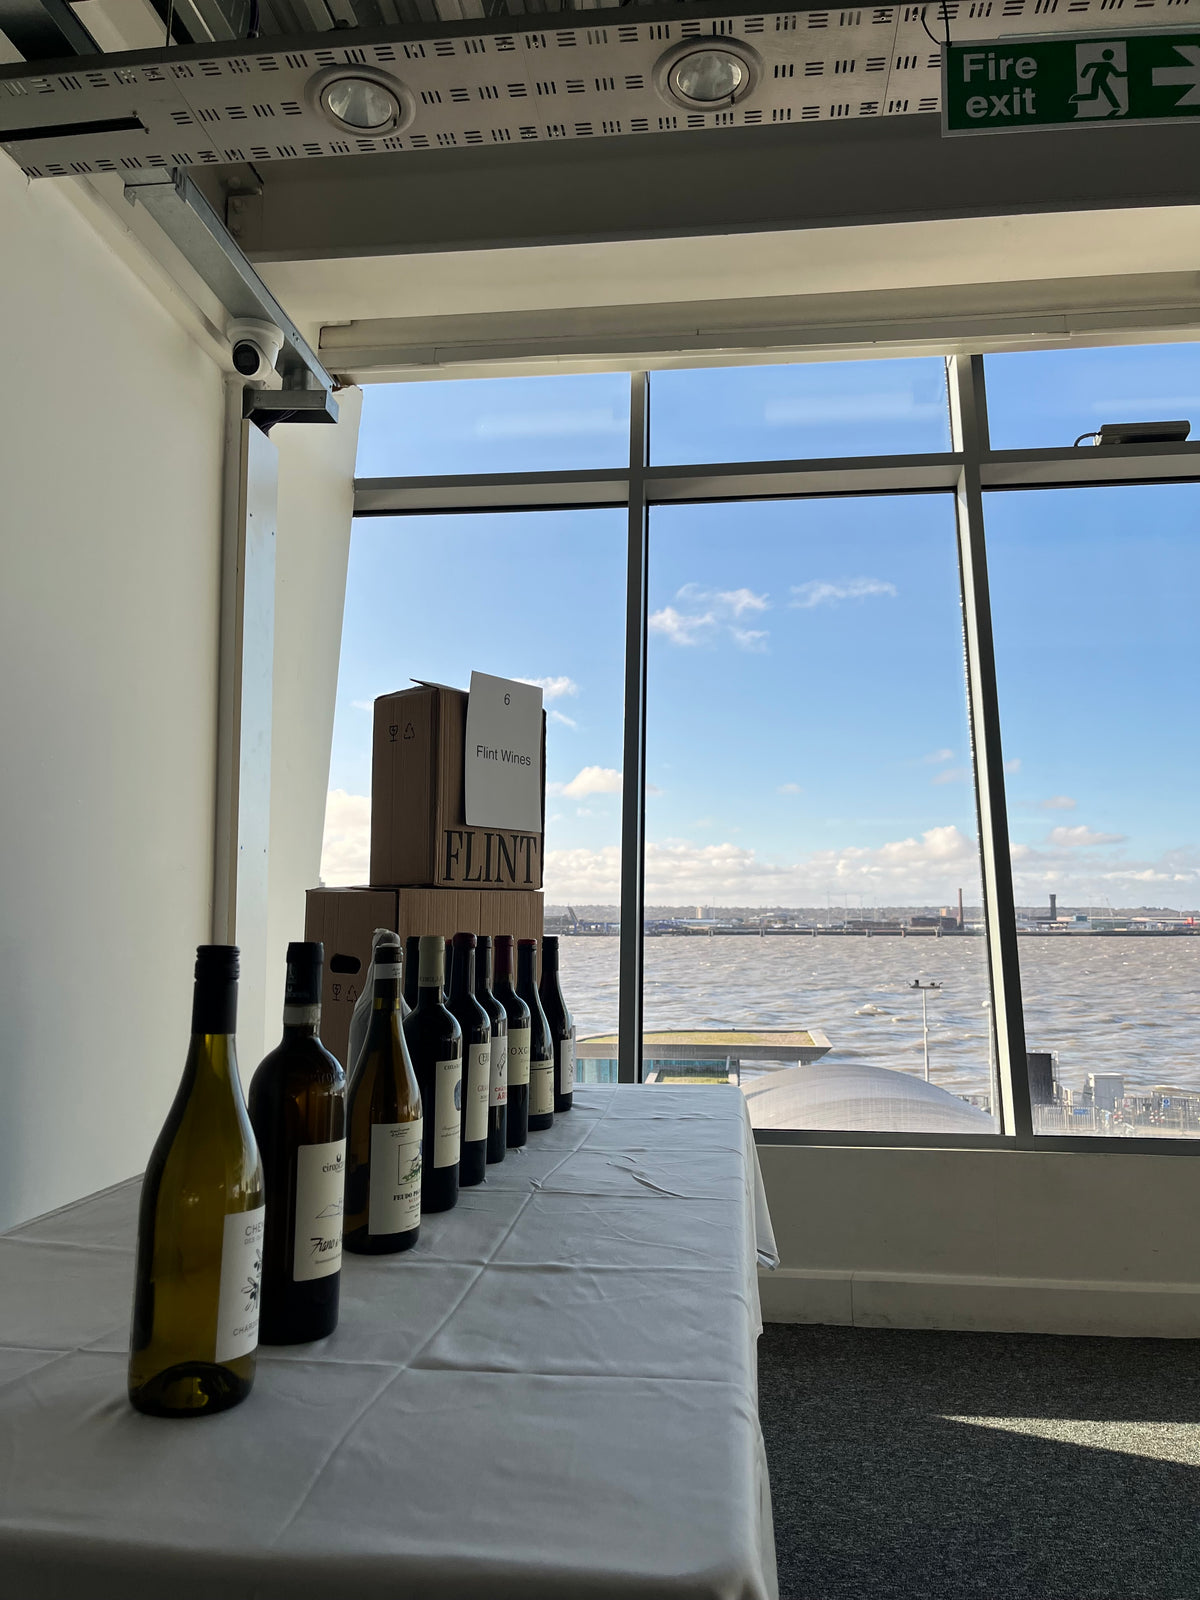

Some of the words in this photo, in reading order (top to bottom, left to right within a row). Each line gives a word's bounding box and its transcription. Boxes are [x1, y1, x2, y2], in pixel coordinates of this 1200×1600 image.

[963, 52, 1038, 83] Fire
[965, 87, 1037, 118] exit
[503, 693, 511, 706] 6
[476, 745, 498, 761] Flint
[500, 749, 531, 766] Wines
[443, 829, 538, 884] FLINT
